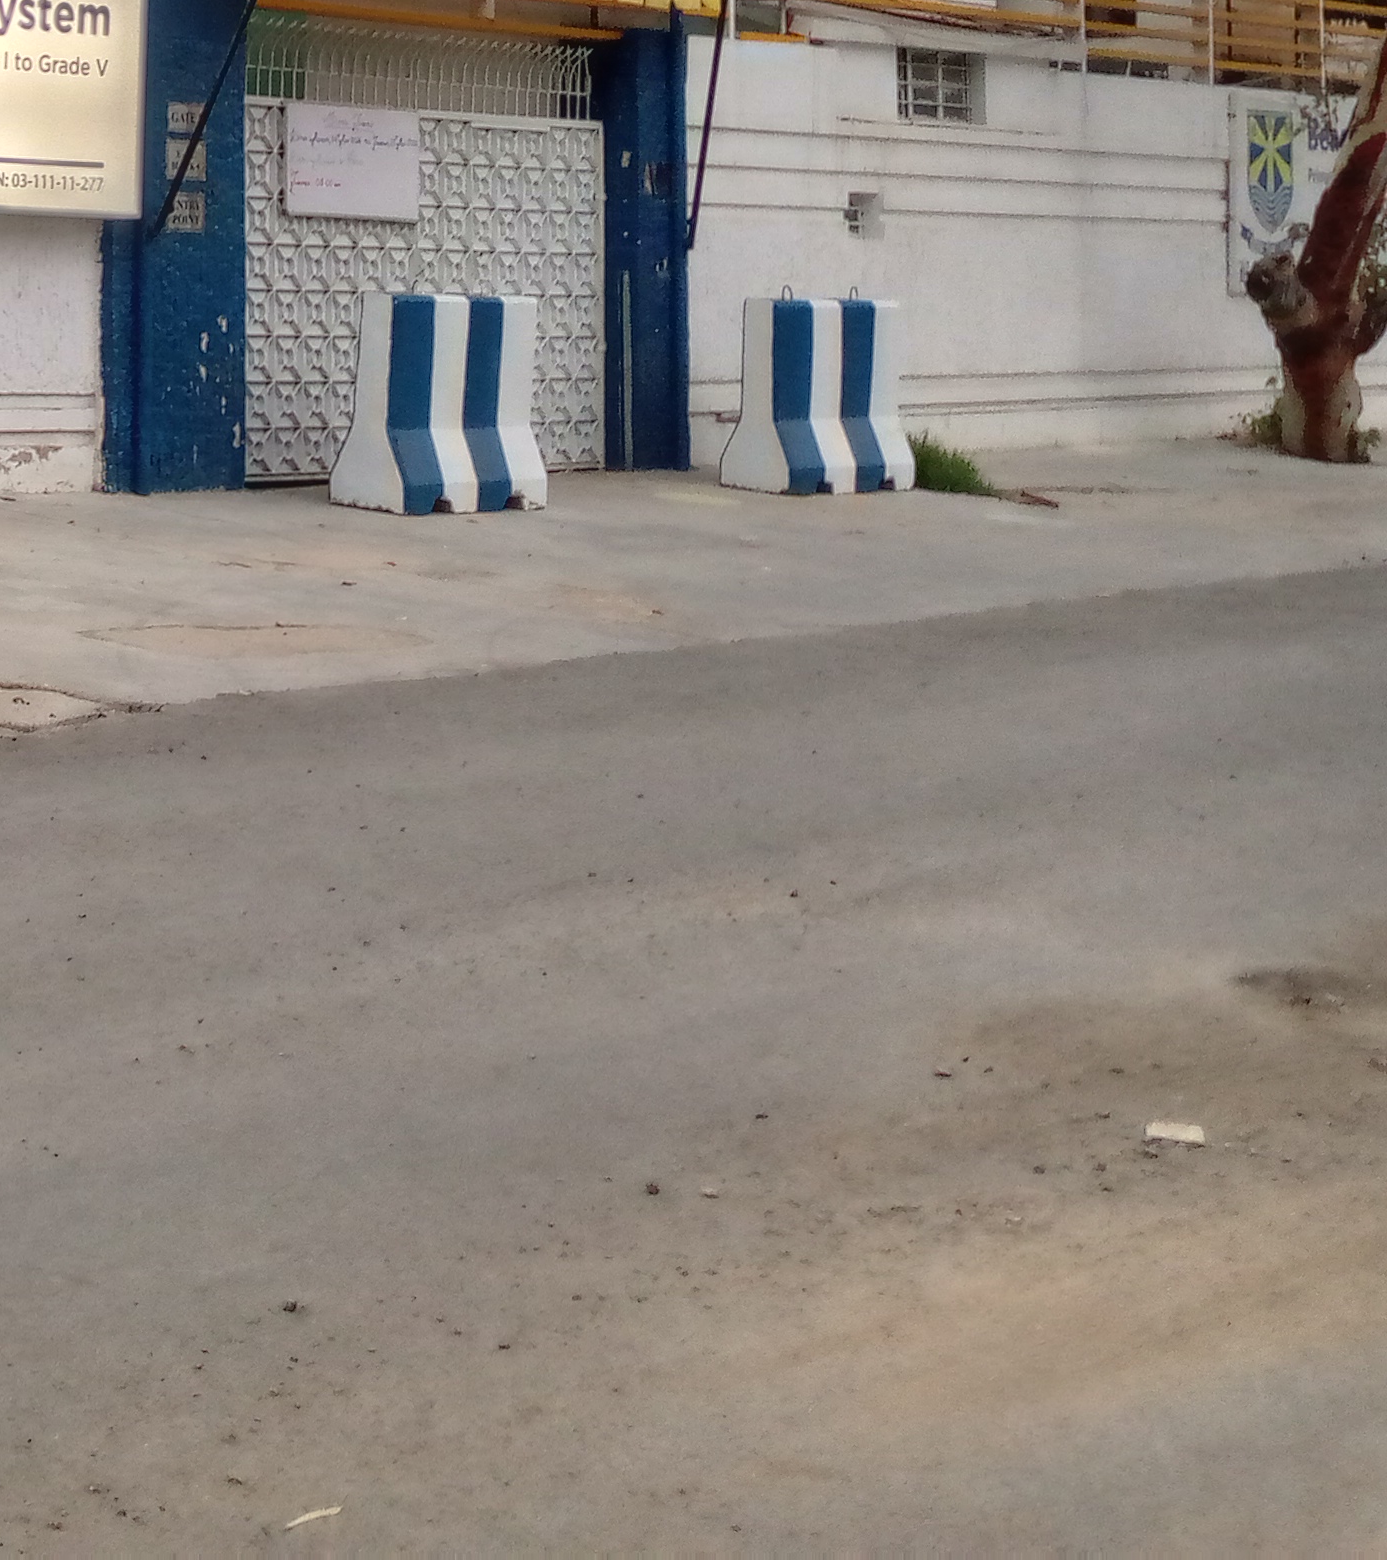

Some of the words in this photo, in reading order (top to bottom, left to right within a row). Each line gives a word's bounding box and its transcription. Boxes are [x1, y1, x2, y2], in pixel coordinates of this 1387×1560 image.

[14, 52, 33, 72] to
[38, 54, 91, 76] Grade
[96, 58, 109, 77] V
[11, 172, 104, 193] 03-111-11-277
[176, 199, 200, 211] NTRY
